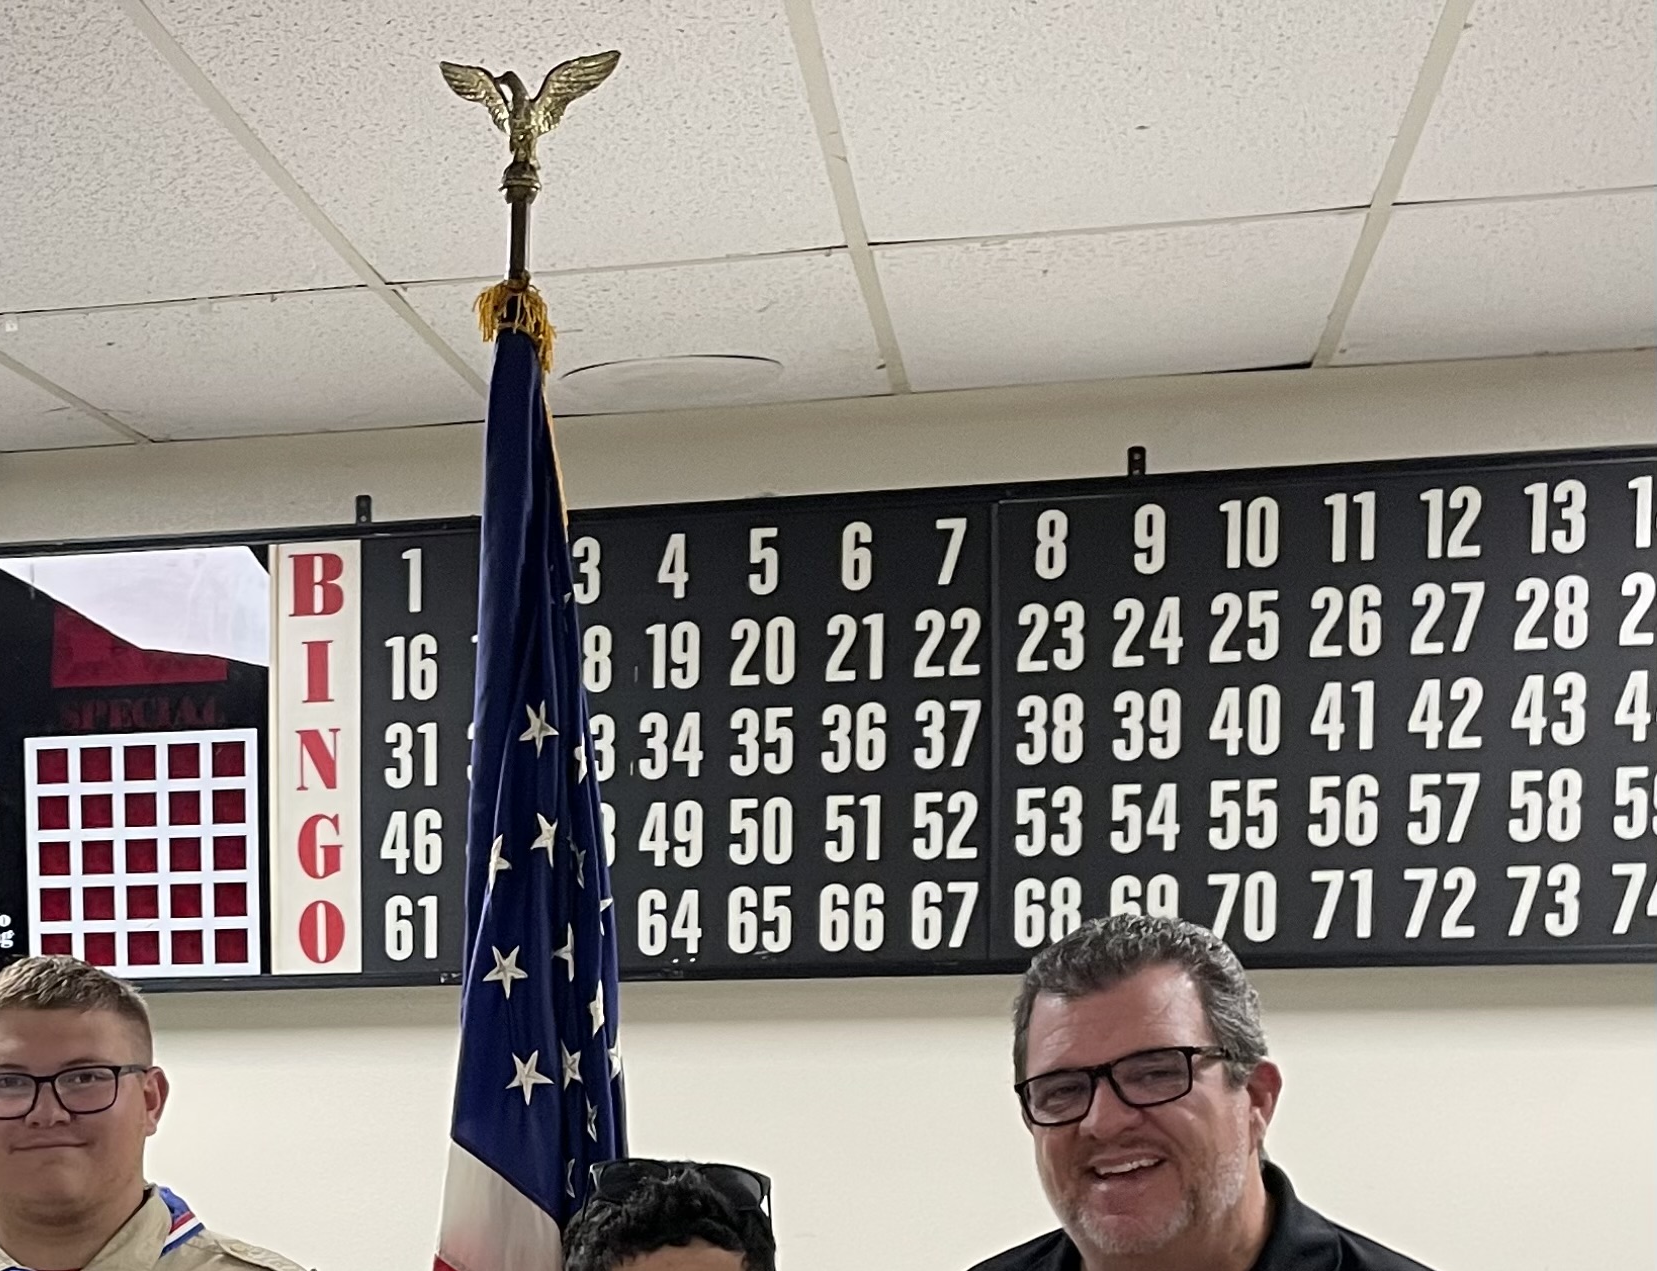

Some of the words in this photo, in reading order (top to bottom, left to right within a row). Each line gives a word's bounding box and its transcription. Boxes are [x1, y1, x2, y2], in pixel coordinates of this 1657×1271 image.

[401, 547, 422, 613] 1
[572, 536, 601, 605] 3
[657, 533, 689, 599] 4
[749, 527, 779, 595] 5
[841, 521, 872, 591] 6
[935, 517, 968, 585] 7
[1035, 509, 1068, 580] 8
[1133, 503, 1166, 575] 9
[1219, 496, 1280, 569] 10
[1324, 491, 1376, 562] 11
[1419, 486, 1482, 559] 12
[1523, 479, 1587, 554] 13
[1627, 475, 1657, 549] 1
[384, 633, 439, 701] 16
[582, 625, 612, 693] 8
[645, 621, 701, 690] 19
[729, 616, 796, 687] 20
[825, 613, 885, 682] 21
[913, 607, 982, 679] 22
[1016, 600, 1086, 673] 23
[1112, 596, 1184, 668] 24
[1208, 589, 1280, 663] 25
[1309, 584, 1382, 658] 26
[1410, 581, 1486, 655] 27
[1513, 574, 1590, 651] 28
[1618, 571, 1657, 647] 2
[286, 551, 346, 964] BINGO
[384, 722, 439, 789] 31
[588, 713, 616, 783] 3
[638, 711, 704, 780] 34
[729, 706, 795, 777] 35
[820, 701, 887, 774] 36
[913, 699, 983, 770] 37
[1016, 692, 1084, 766] 38
[1112, 688, 1182, 762] 39
[1208, 683, 1281, 757] 40
[1310, 680, 1375, 752] 41
[1407, 676, 1485, 750] 42
[1510, 671, 1587, 746] 43
[1614, 669, 1657, 742] 4
[380, 808, 443, 875] 46
[638, 799, 704, 868] 49
[728, 796, 794, 866] 50
[824, 794, 881, 863] 51
[912, 790, 979, 861] 52
[1014, 785, 1083, 857] 53
[1110, 783, 1181, 854] 54
[1208, 778, 1278, 851] 55
[1307, 773, 1379, 848] 56
[1407, 772, 1481, 846] 57
[1508, 767, 1583, 843] 58
[1613, 765, 1657, 840] 5
[384, 894, 439, 961] 61
[637, 888, 703, 956] 64
[727, 885, 793, 955] 65
[819, 882, 886, 952] 66
[911, 881, 980, 950] 67
[1013, 876, 1083, 948] 68
[1109, 872, 1180, 921] 69
[1208, 869, 1278, 943] 70
[1310, 868, 1375, 940] 71
[1403, 866, 1478, 939] 72
[1506, 862, 1581, 938] 73
